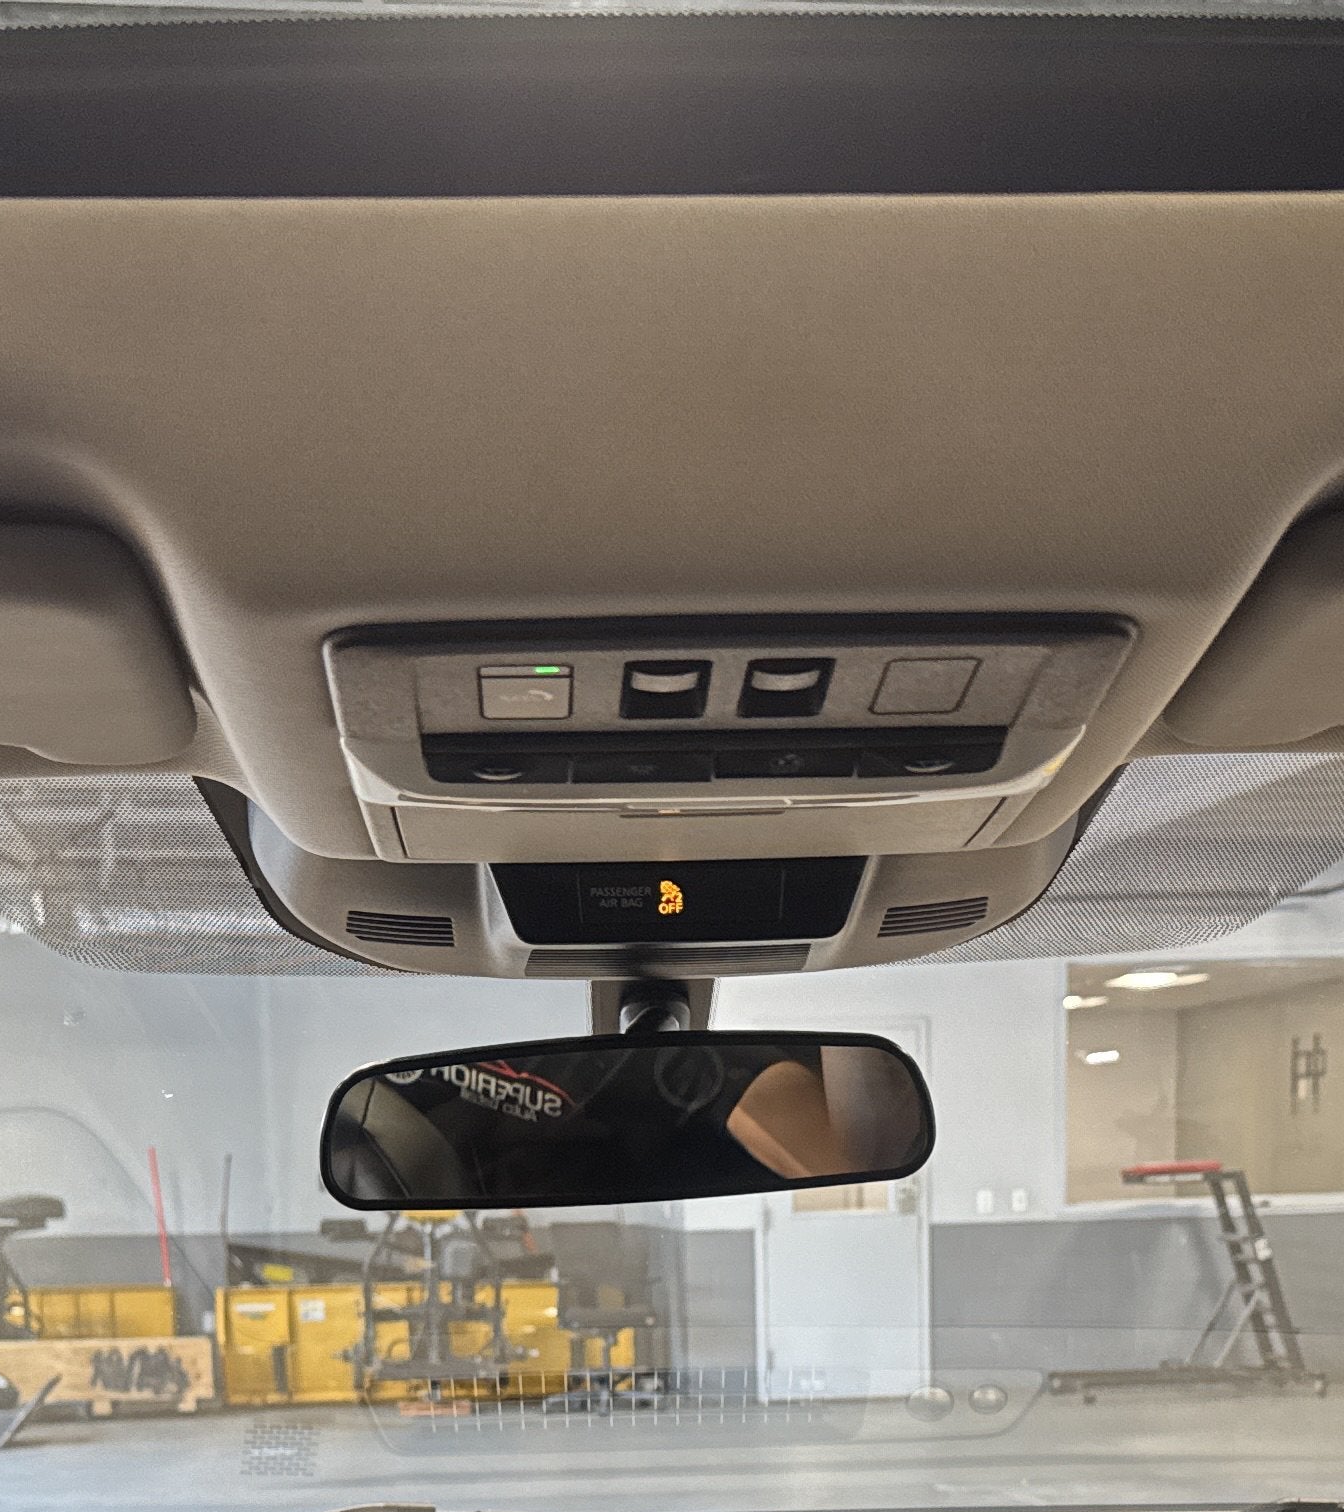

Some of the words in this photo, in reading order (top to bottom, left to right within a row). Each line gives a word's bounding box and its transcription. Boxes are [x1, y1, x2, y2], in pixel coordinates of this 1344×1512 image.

[590, 886, 652, 897] PASSENGER
[599, 898, 618, 908] AIR
[621, 898, 644, 908] BAG
[658, 902, 684, 914] OFF
